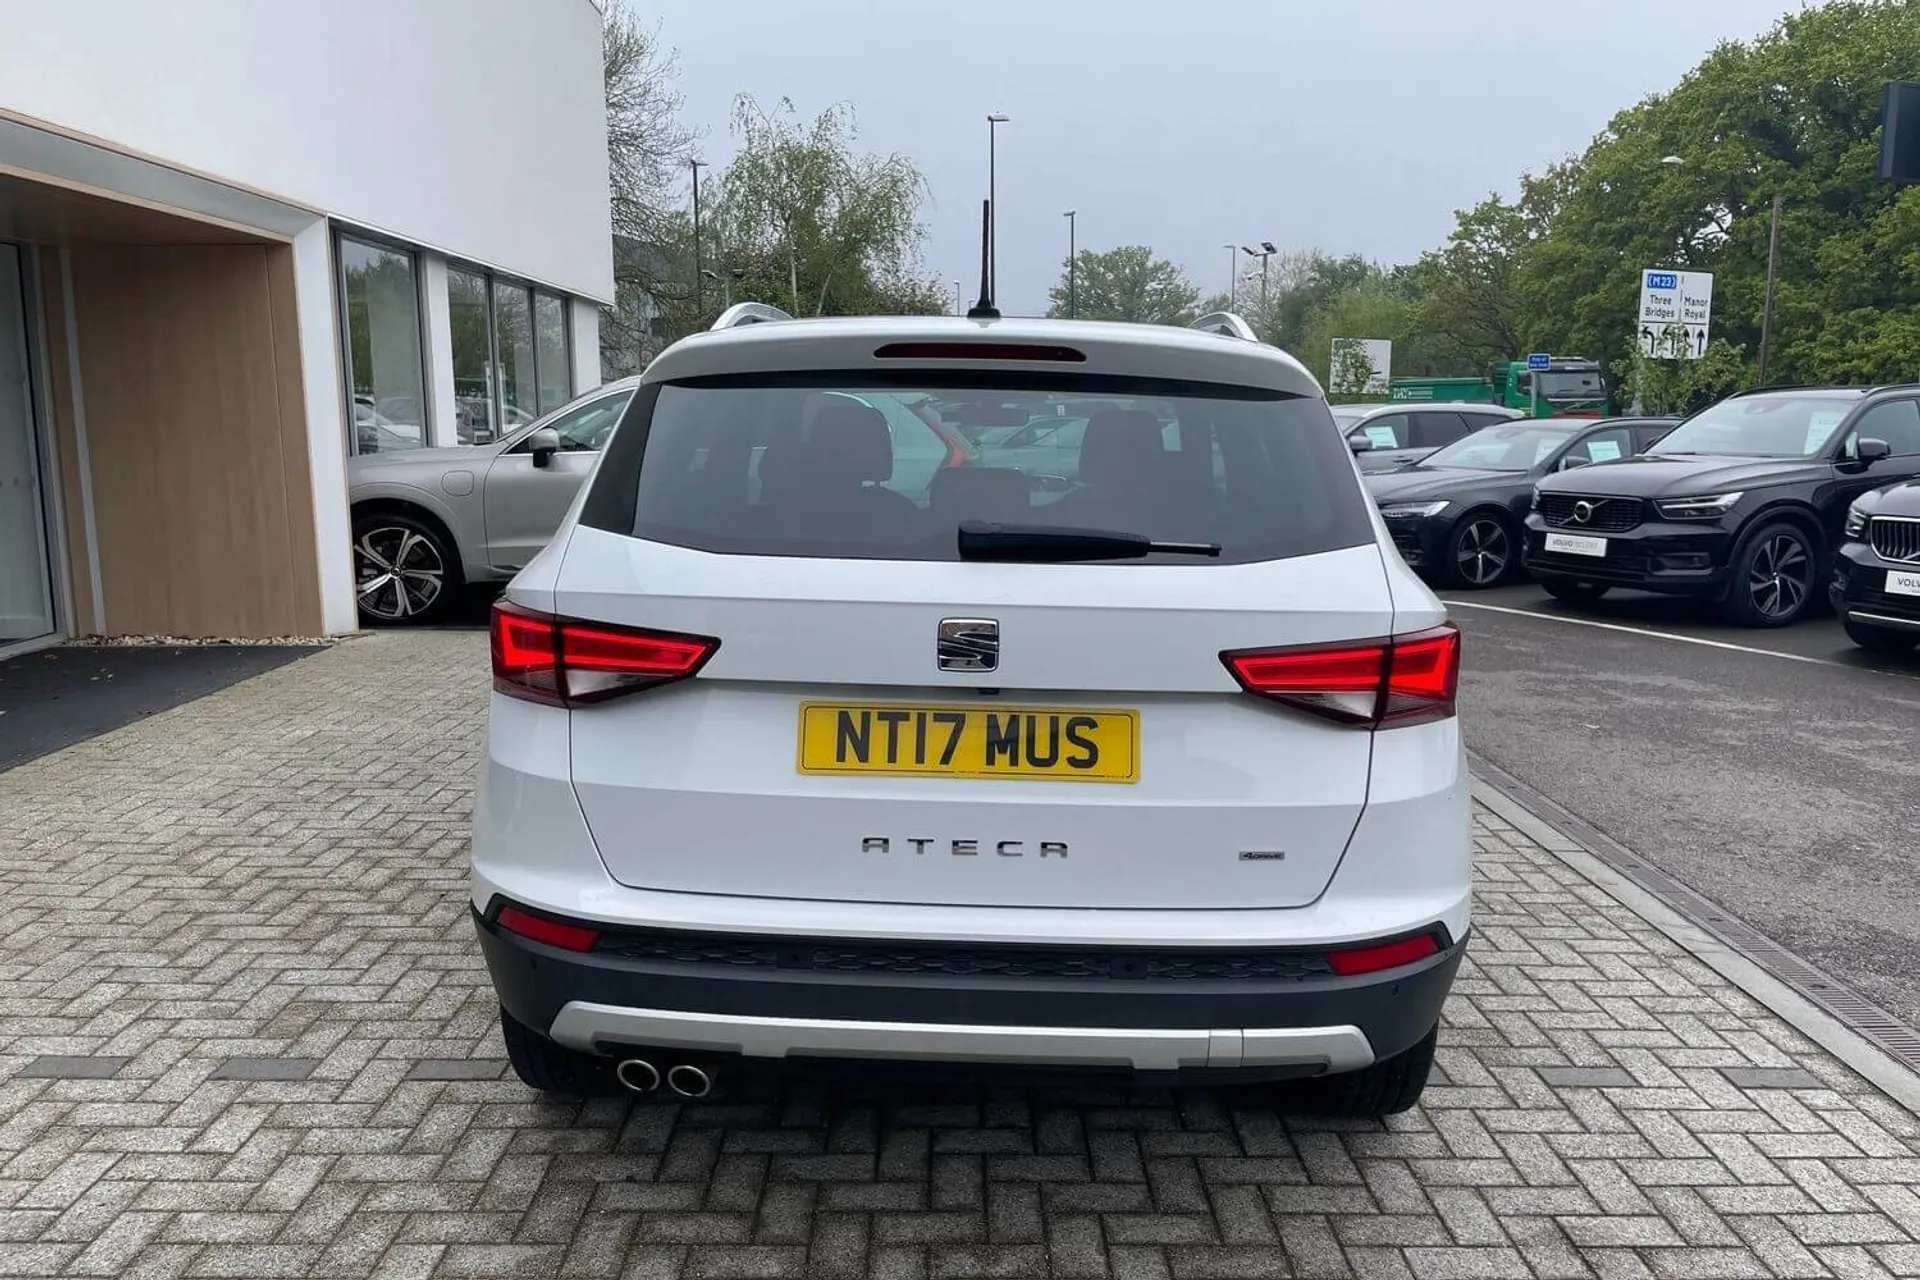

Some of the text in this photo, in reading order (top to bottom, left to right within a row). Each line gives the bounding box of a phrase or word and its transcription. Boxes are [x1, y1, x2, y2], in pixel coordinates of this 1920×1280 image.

[1650, 295, 1672, 305] Three
[1684, 297, 1708, 306] Manor
[1645, 307, 1675, 318] Bridges
[1684, 309, 1706, 319] Royal
[835, 710, 1099, 769] NT17 MUS
[862, 837, 1068, 859] ATECA
